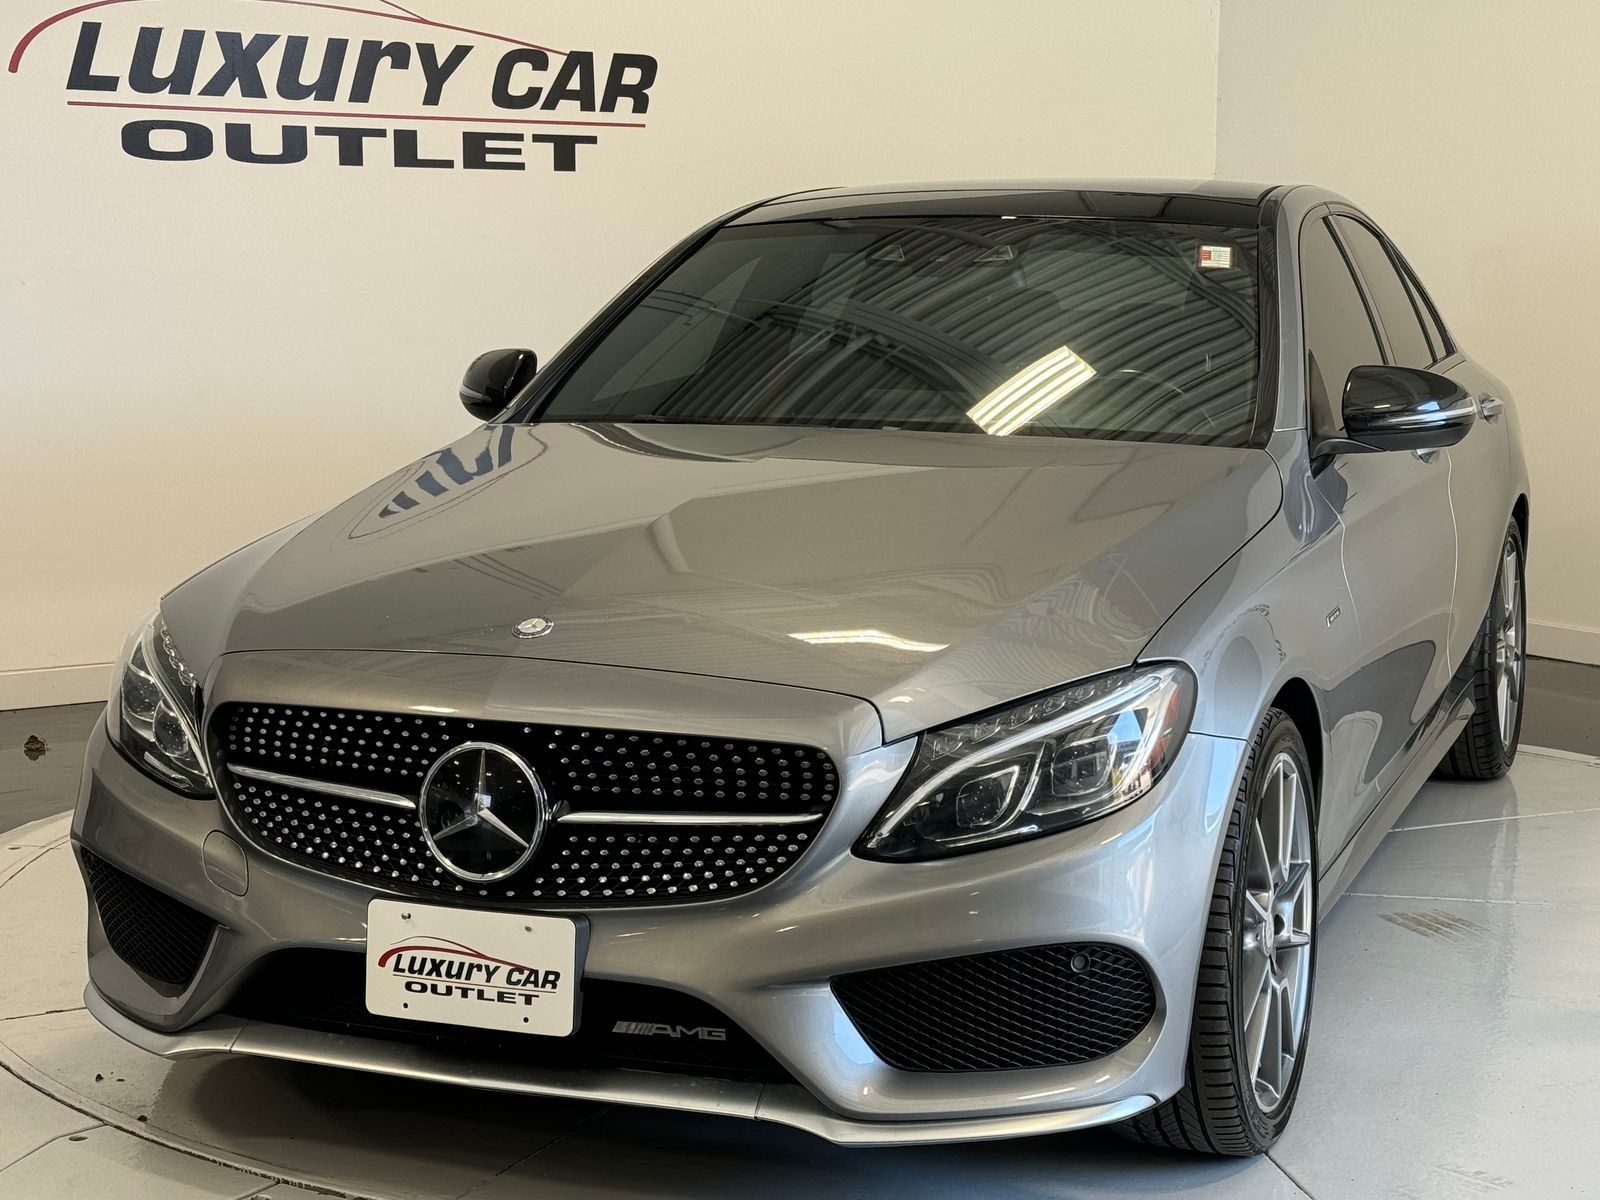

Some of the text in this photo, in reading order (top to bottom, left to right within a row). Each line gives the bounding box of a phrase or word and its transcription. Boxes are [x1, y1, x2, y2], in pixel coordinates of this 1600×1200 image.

[491, 47, 658, 114] CAR
[120, 119, 598, 172] OUTLET
[505, 967, 561, 990] CAR
[404, 981, 540, 1006] OUTLET
[648, 1023, 727, 1041] AMG
